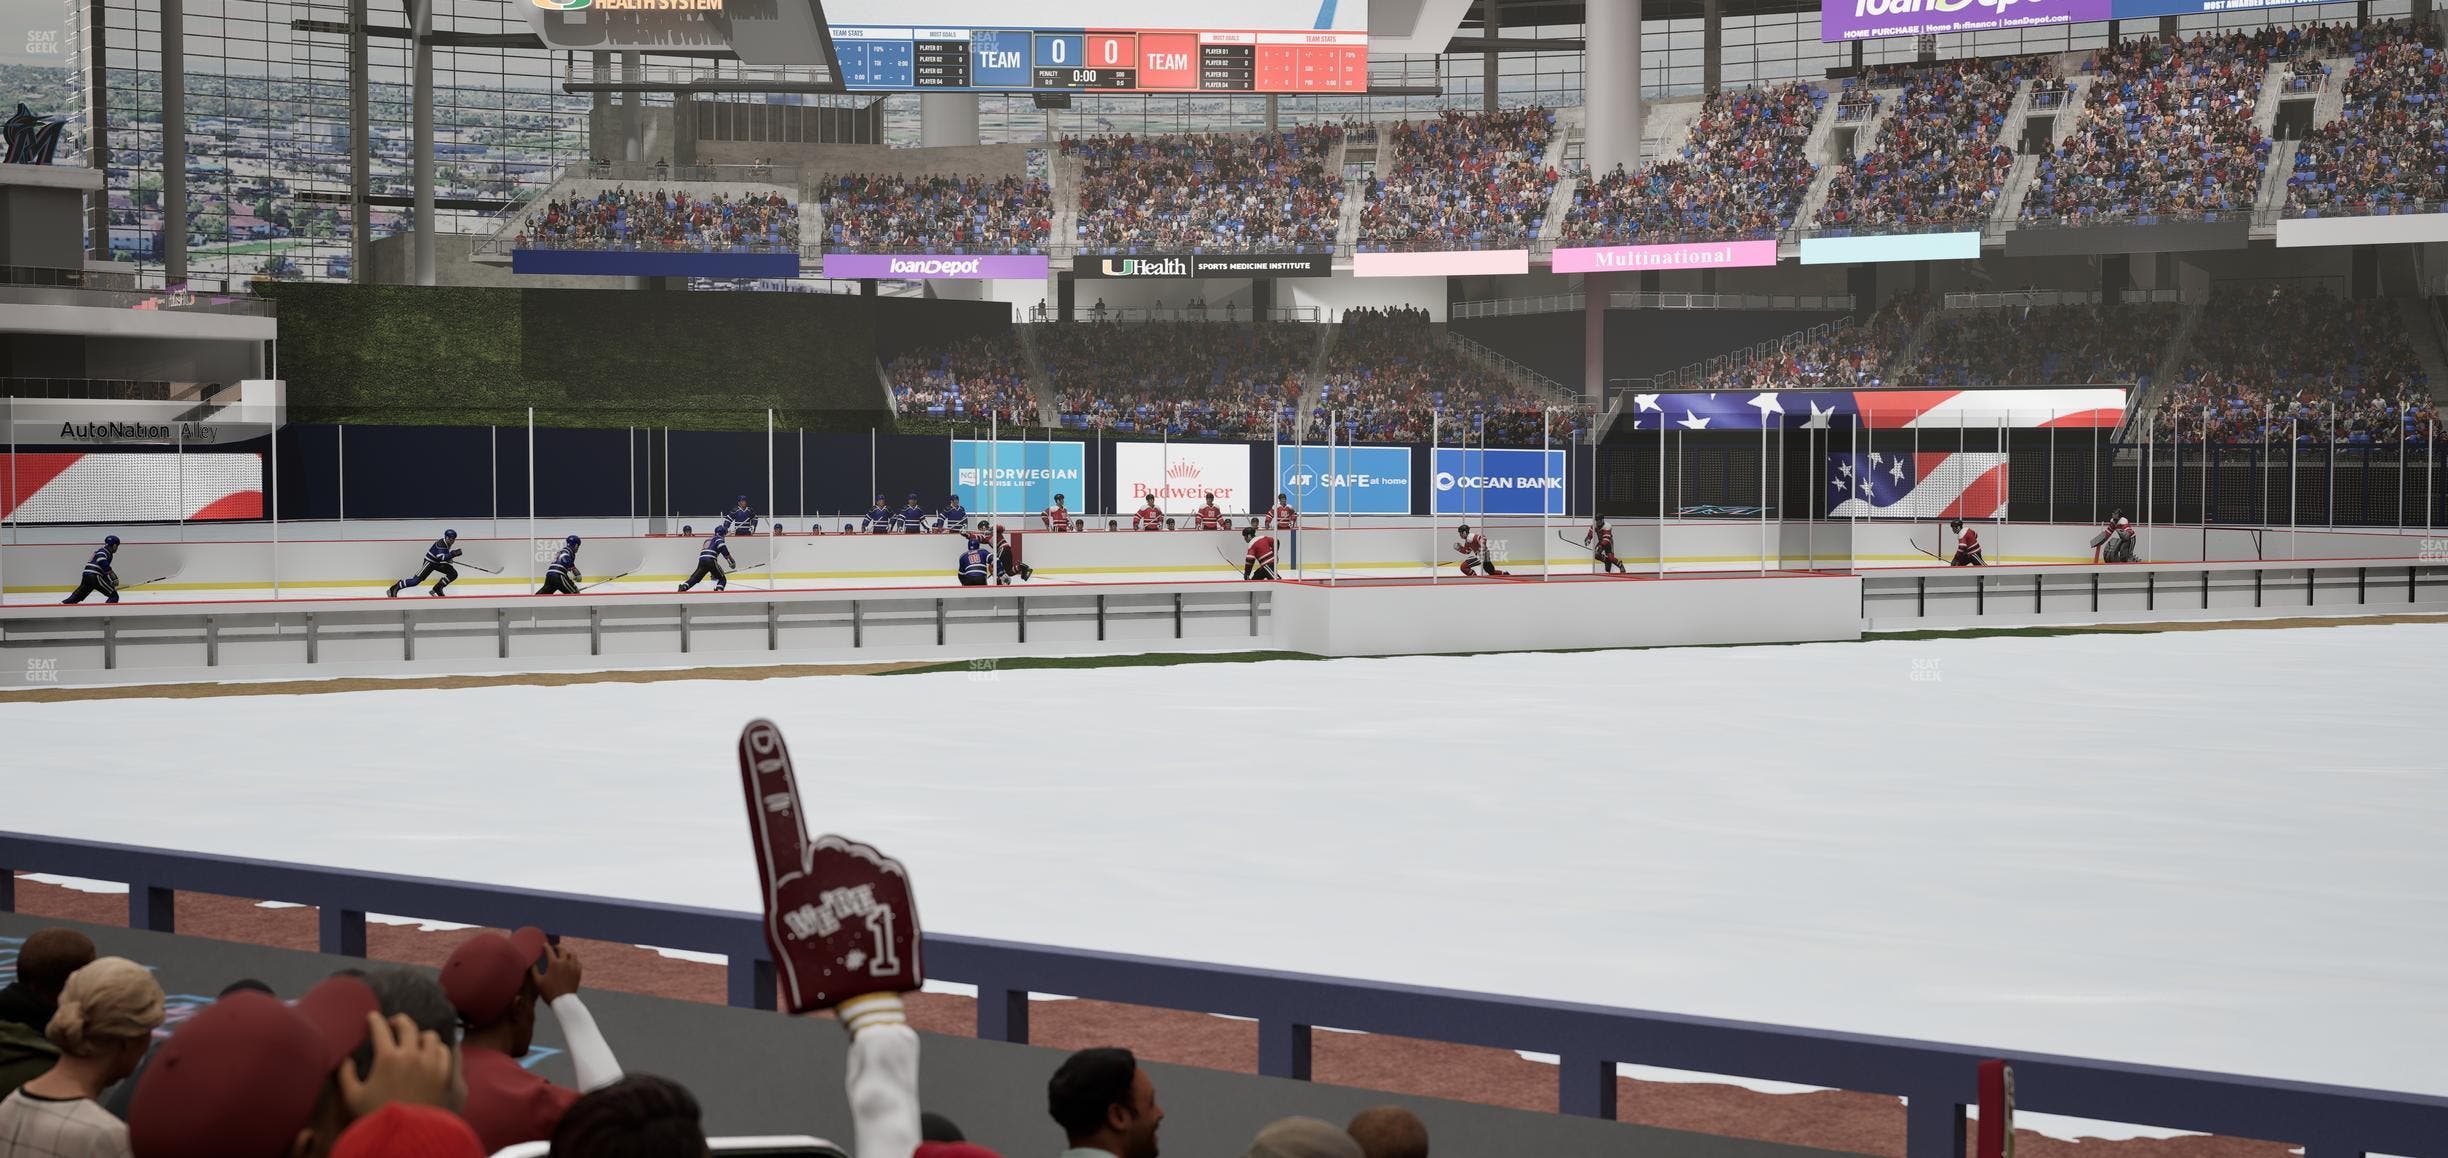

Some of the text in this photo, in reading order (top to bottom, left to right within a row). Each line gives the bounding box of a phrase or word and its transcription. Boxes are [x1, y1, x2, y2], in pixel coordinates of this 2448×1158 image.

[595, 0, 723, 10] HEALTH SYSTEM
[1844, 30, 1869, 39] HOME
[1871, 25, 1919, 37] PURCHASE
[1926, 22, 1951, 33] Home
[980, 51, 1020, 68] TEAM
[1052, 39, 1065, 64] 0
[1104, 39, 1118, 64] 0
[1147, 53, 1188, 70] TEAM
[1073, 70, 1097, 82] 0:00
[1595, 247, 1732, 267] Multinational
[890, 258, 980, 276] loanDepot
[1230, 262, 1268, 270] MEDICINE
[1269, 262, 1311, 270] INSTITUTE
[60, 422, 218, 443] AutoNation Alley
[983, 468, 1078, 480] NORWEGIAN
[1321, 474, 1407, 487] SAFE at home
[1457, 476, 1562, 489] OCEAN BANK
[1133, 483, 1233, 499] Budweiser
